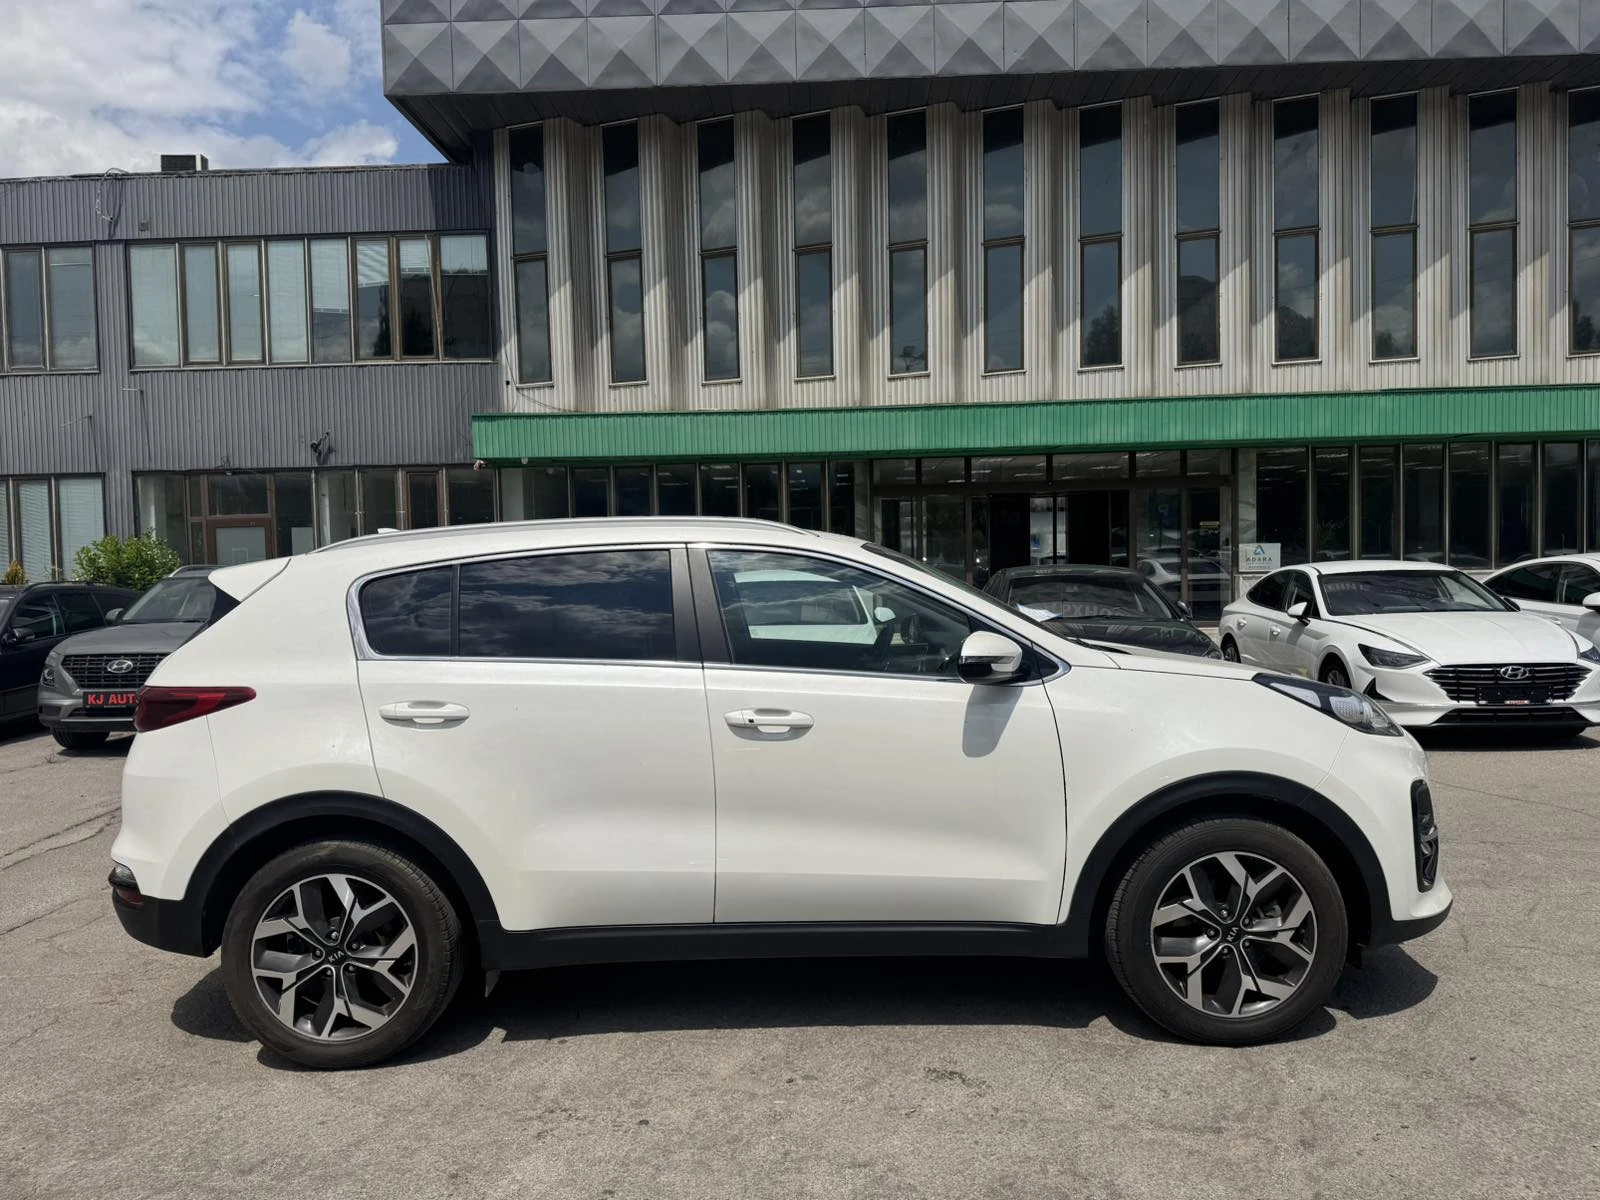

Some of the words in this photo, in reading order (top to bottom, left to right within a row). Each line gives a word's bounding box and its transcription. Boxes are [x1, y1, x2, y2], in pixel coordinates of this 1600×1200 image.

[87, 693, 105, 705] KJ
[108, 693, 136, 705] AUT
[1226, 927, 1239, 942] KIA
[328, 950, 344, 963] KIA
